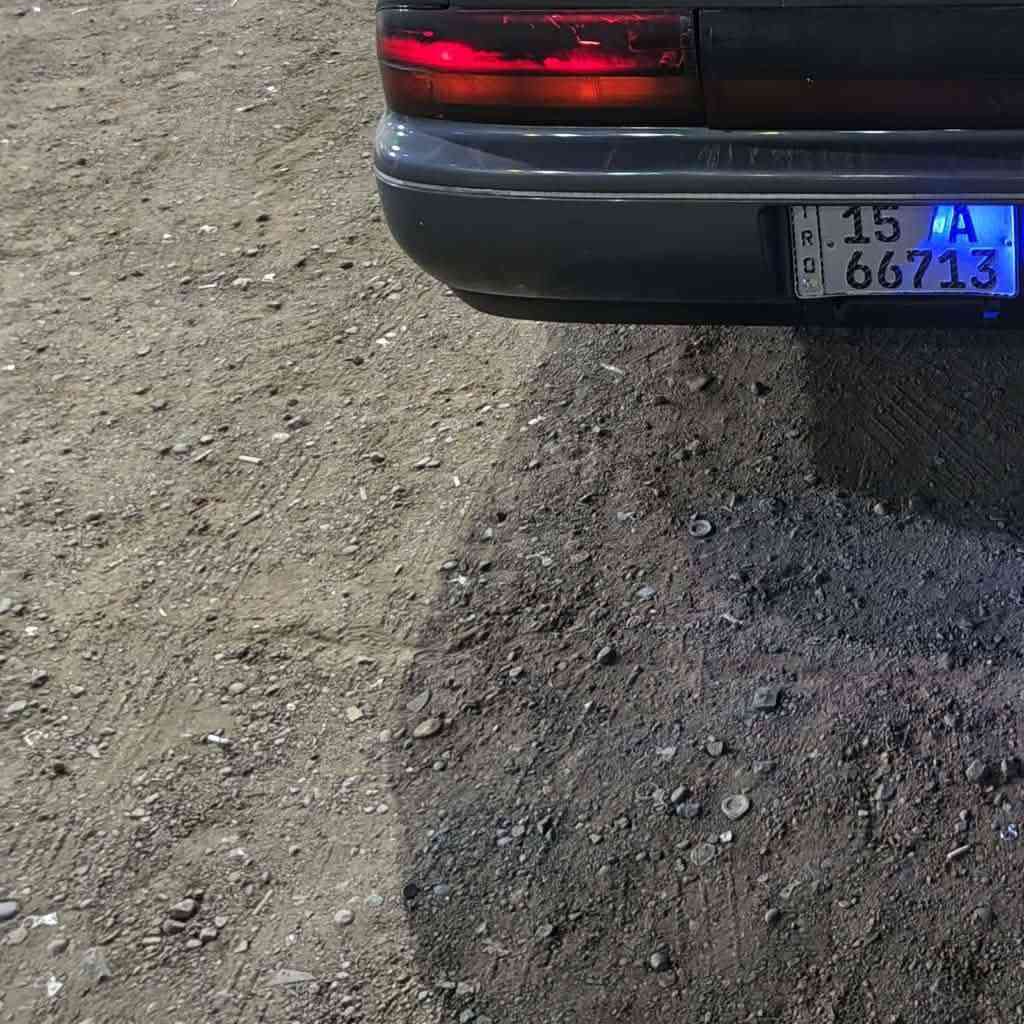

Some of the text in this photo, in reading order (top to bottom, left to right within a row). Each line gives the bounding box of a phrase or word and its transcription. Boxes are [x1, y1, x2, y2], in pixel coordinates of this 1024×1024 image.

[841, 204, 977, 244] 15 A
[846, 249, 998, 290] 66713
